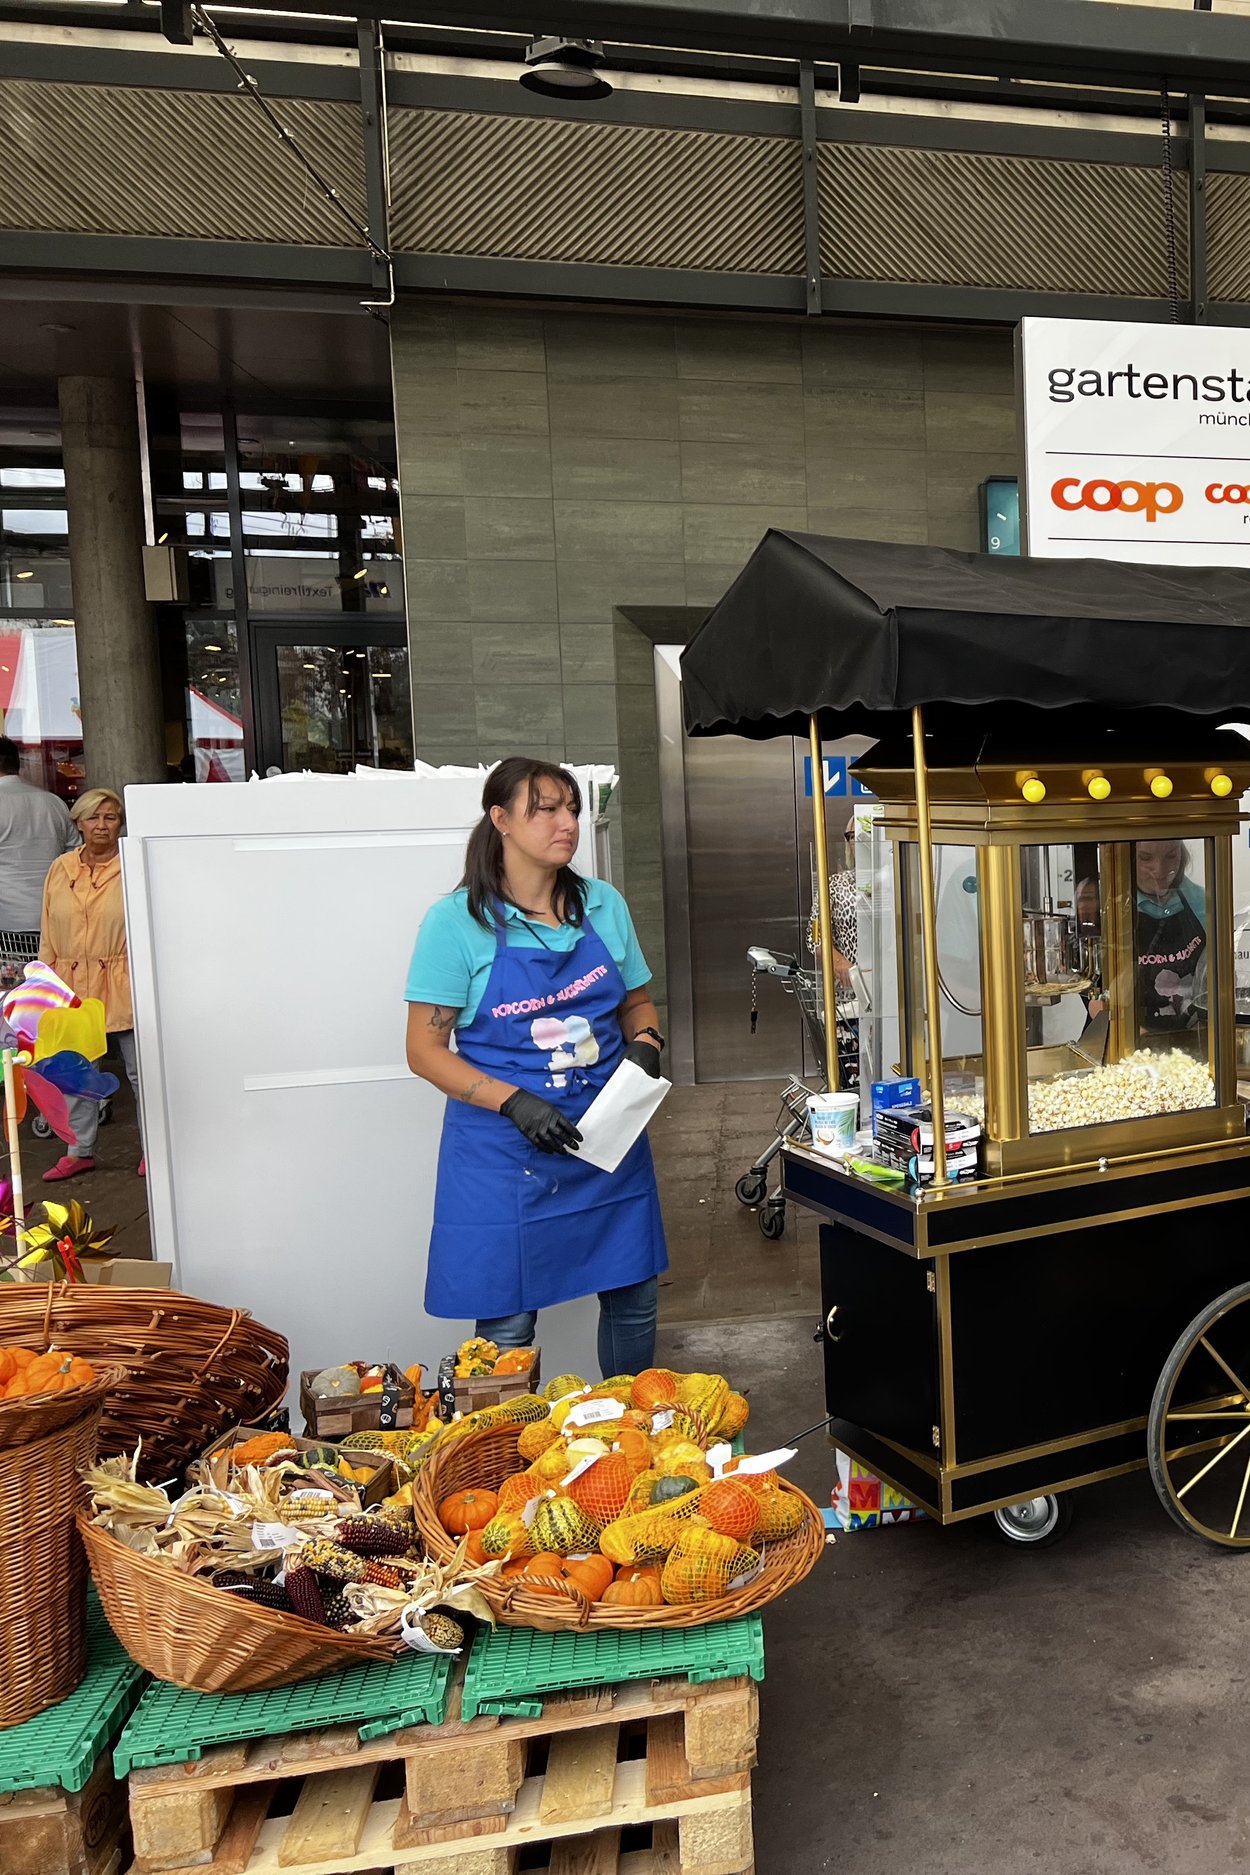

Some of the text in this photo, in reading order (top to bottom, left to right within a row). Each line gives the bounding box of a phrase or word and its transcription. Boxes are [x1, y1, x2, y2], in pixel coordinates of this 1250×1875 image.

[1050, 477, 1184, 523] coop
[990, 536, 1001, 550] 9
[491, 996, 546, 1018] POPCORN
